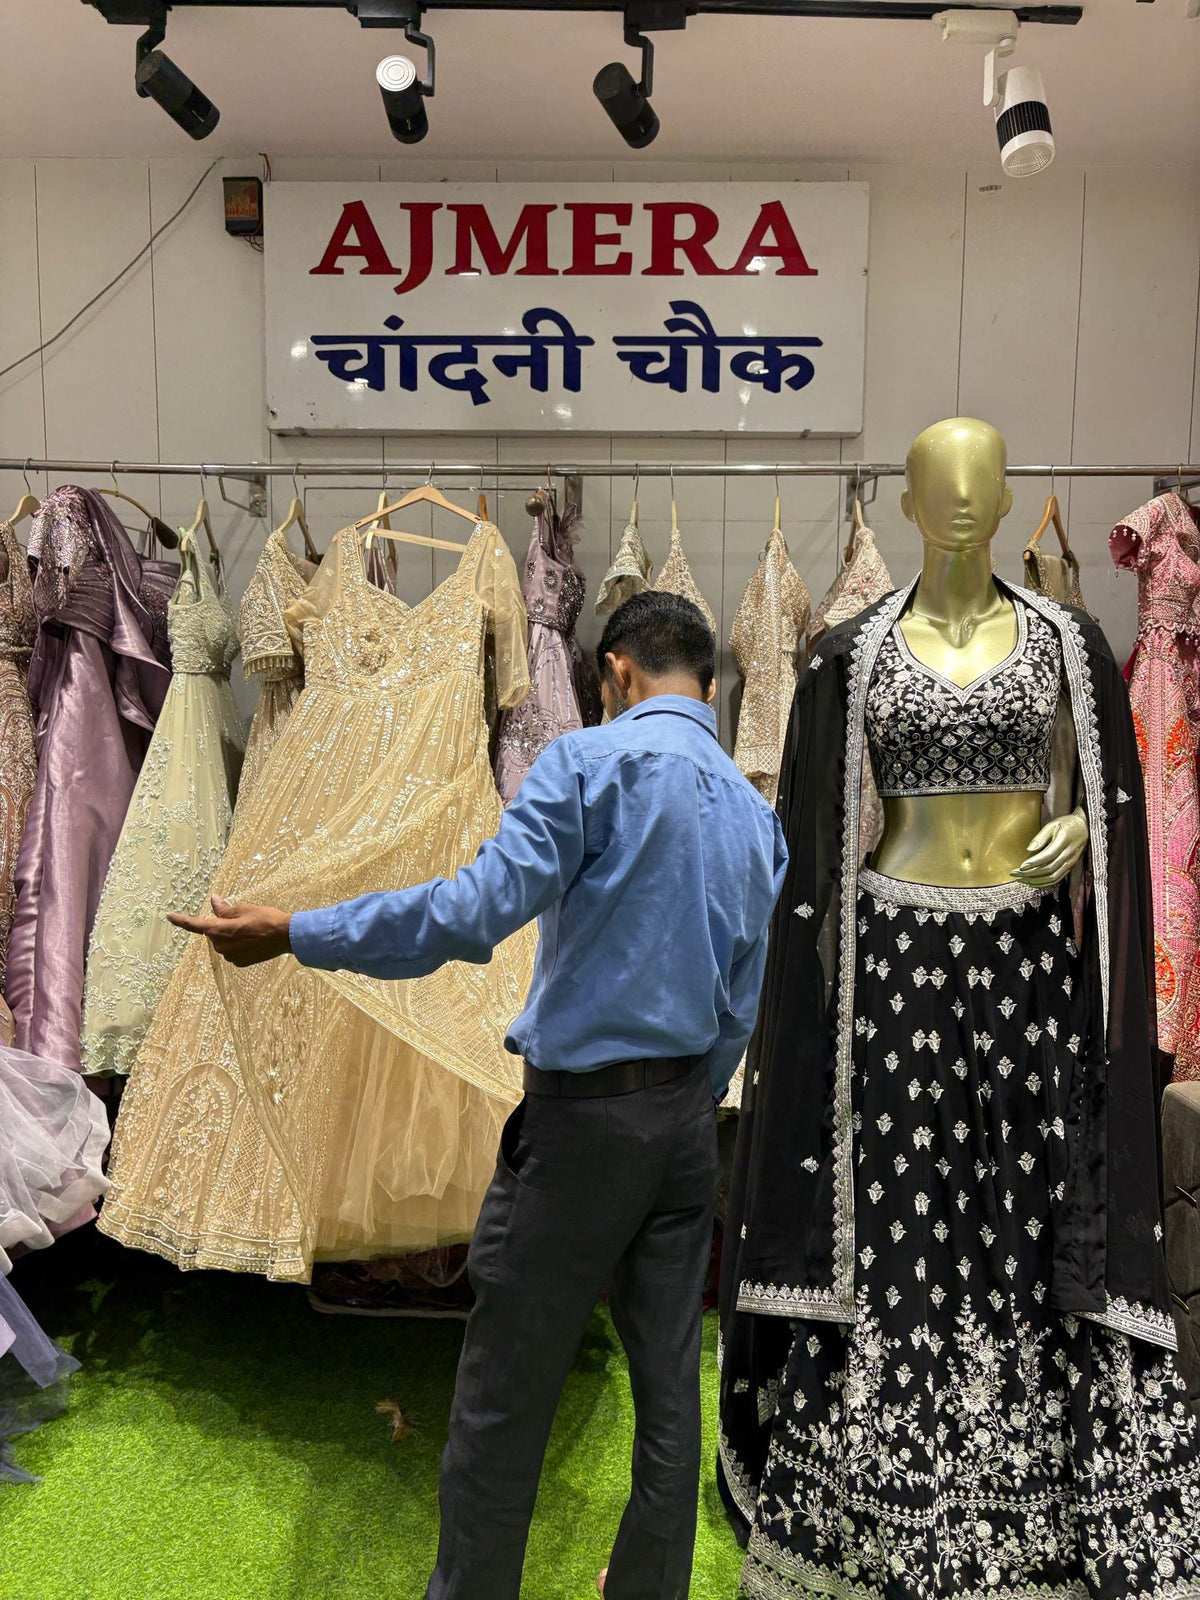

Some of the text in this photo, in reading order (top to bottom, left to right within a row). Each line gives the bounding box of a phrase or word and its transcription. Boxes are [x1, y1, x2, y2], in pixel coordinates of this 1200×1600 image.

[309, 200, 818, 294] AJMERA
[310, 301, 823, 405] चांदनी चौक
